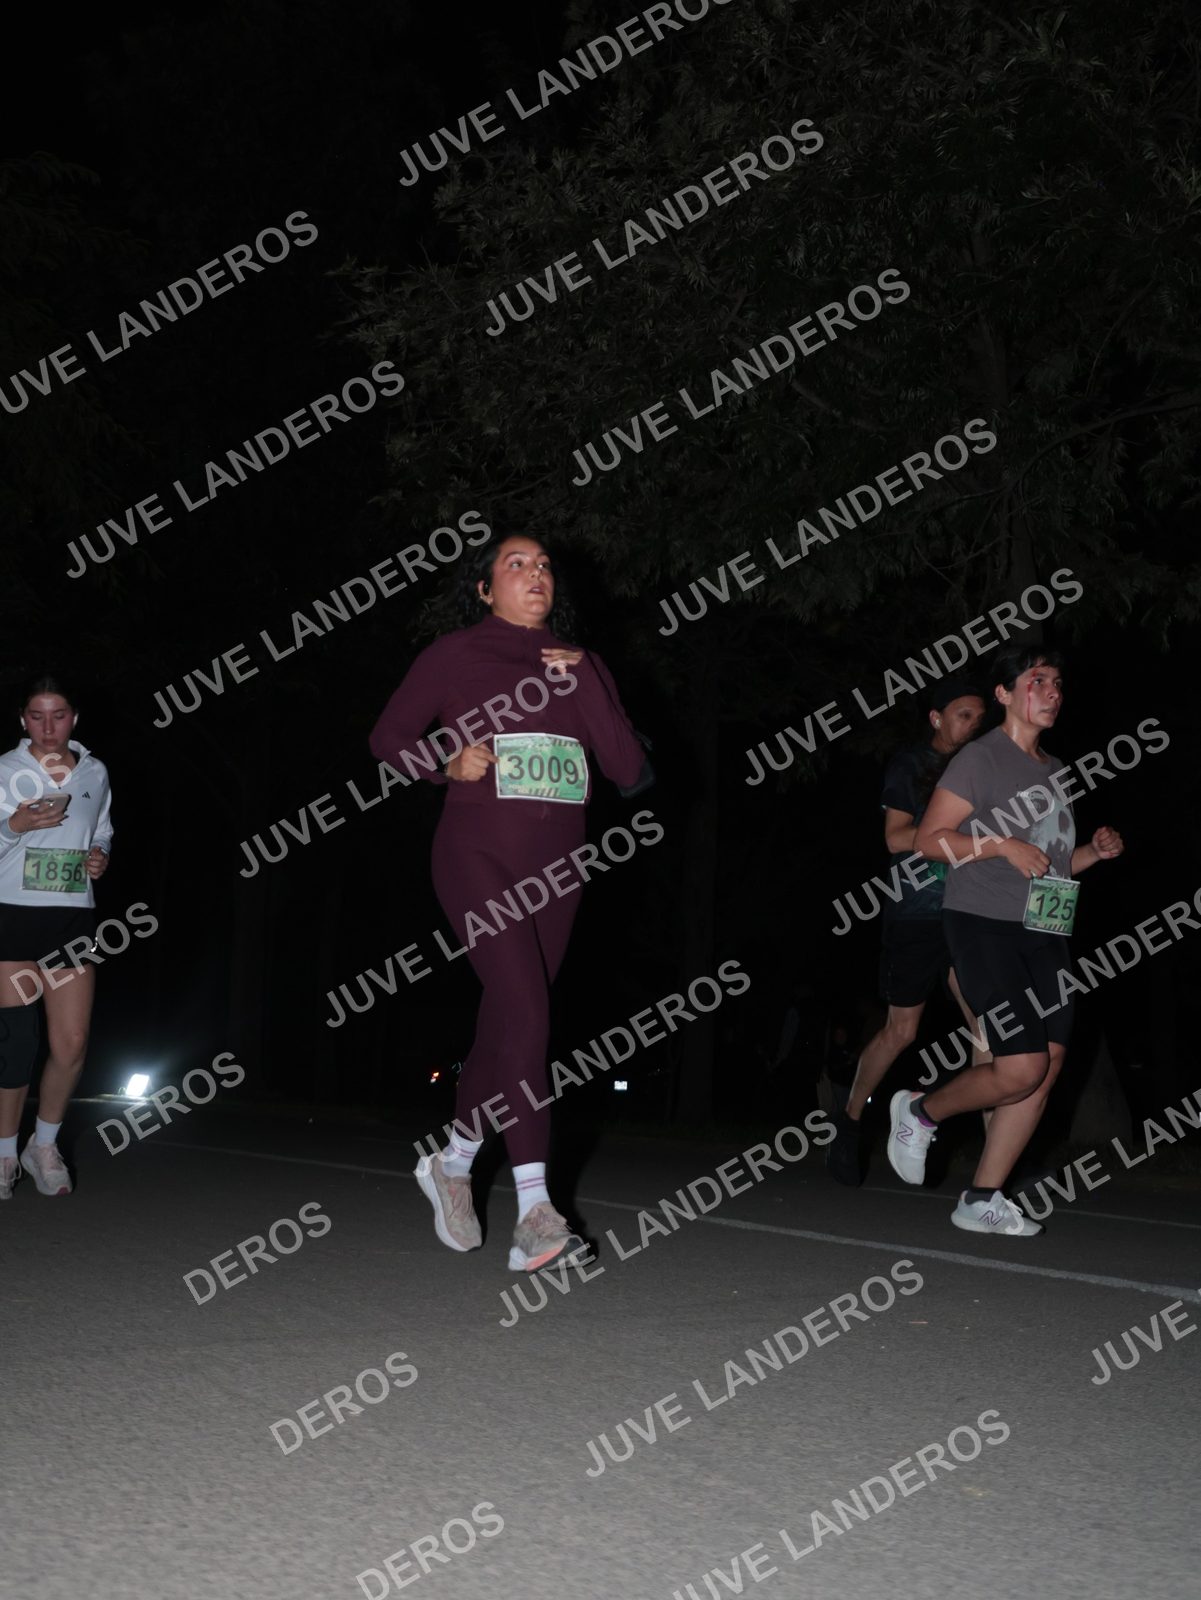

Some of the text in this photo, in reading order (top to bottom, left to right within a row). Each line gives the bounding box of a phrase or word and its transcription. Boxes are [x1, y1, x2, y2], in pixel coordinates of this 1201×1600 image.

[507, 755, 579, 785] 3009
[31, 860, 83, 882] 1856
[1035, 893, 1075, 921] 125
